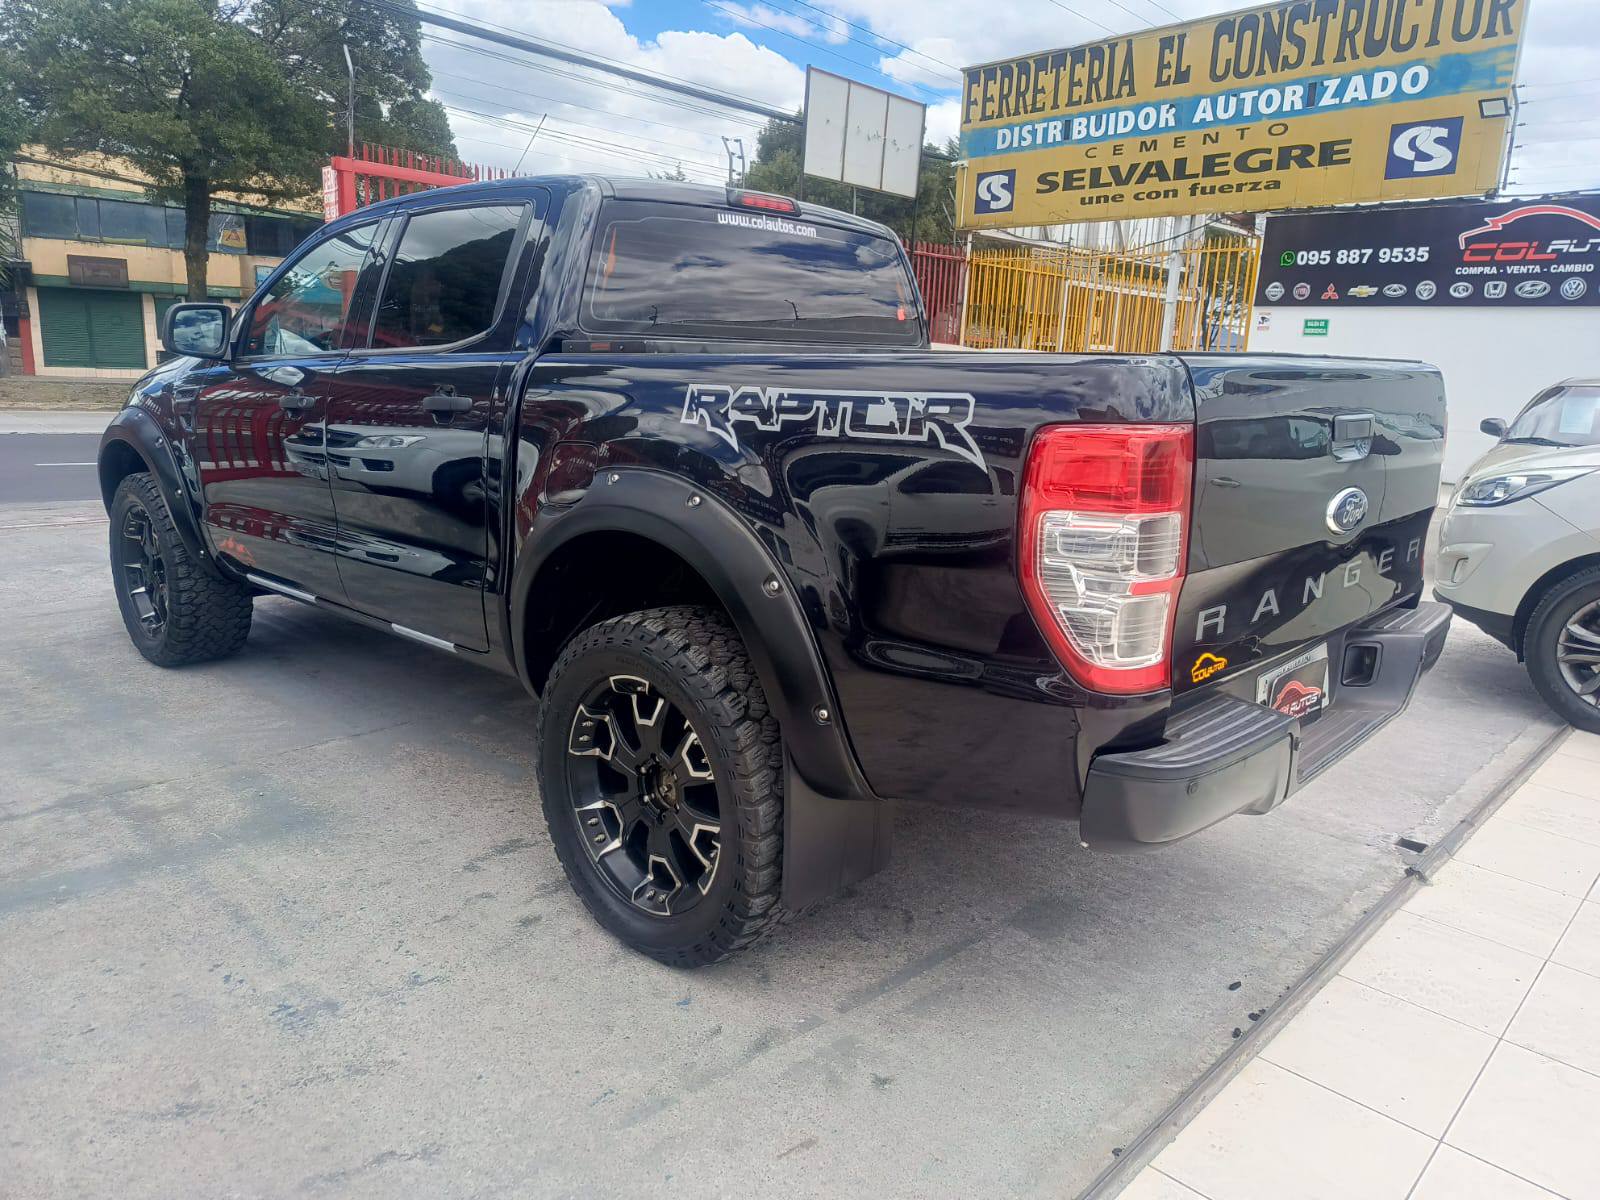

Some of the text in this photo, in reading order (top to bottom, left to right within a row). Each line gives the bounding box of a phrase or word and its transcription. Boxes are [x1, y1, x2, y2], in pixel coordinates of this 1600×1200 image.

[963, 0, 1513, 125] FERRETERIA EL CONSTRUCTOR
[1085, 122, 1288, 159] CEMENTO
[1036, 138, 1352, 194] SELVALEGRE
[1080, 178, 1281, 206] une con fuerza
[717, 212, 817, 238] www.colautos.com
[1296, 247, 1430, 266] 095 887 9535
[1455, 263, 1594, 275] COMPRA VENTA CAMBIO
[680, 383, 988, 474] RAPTOR
[1195, 538, 1421, 642] RANGER
